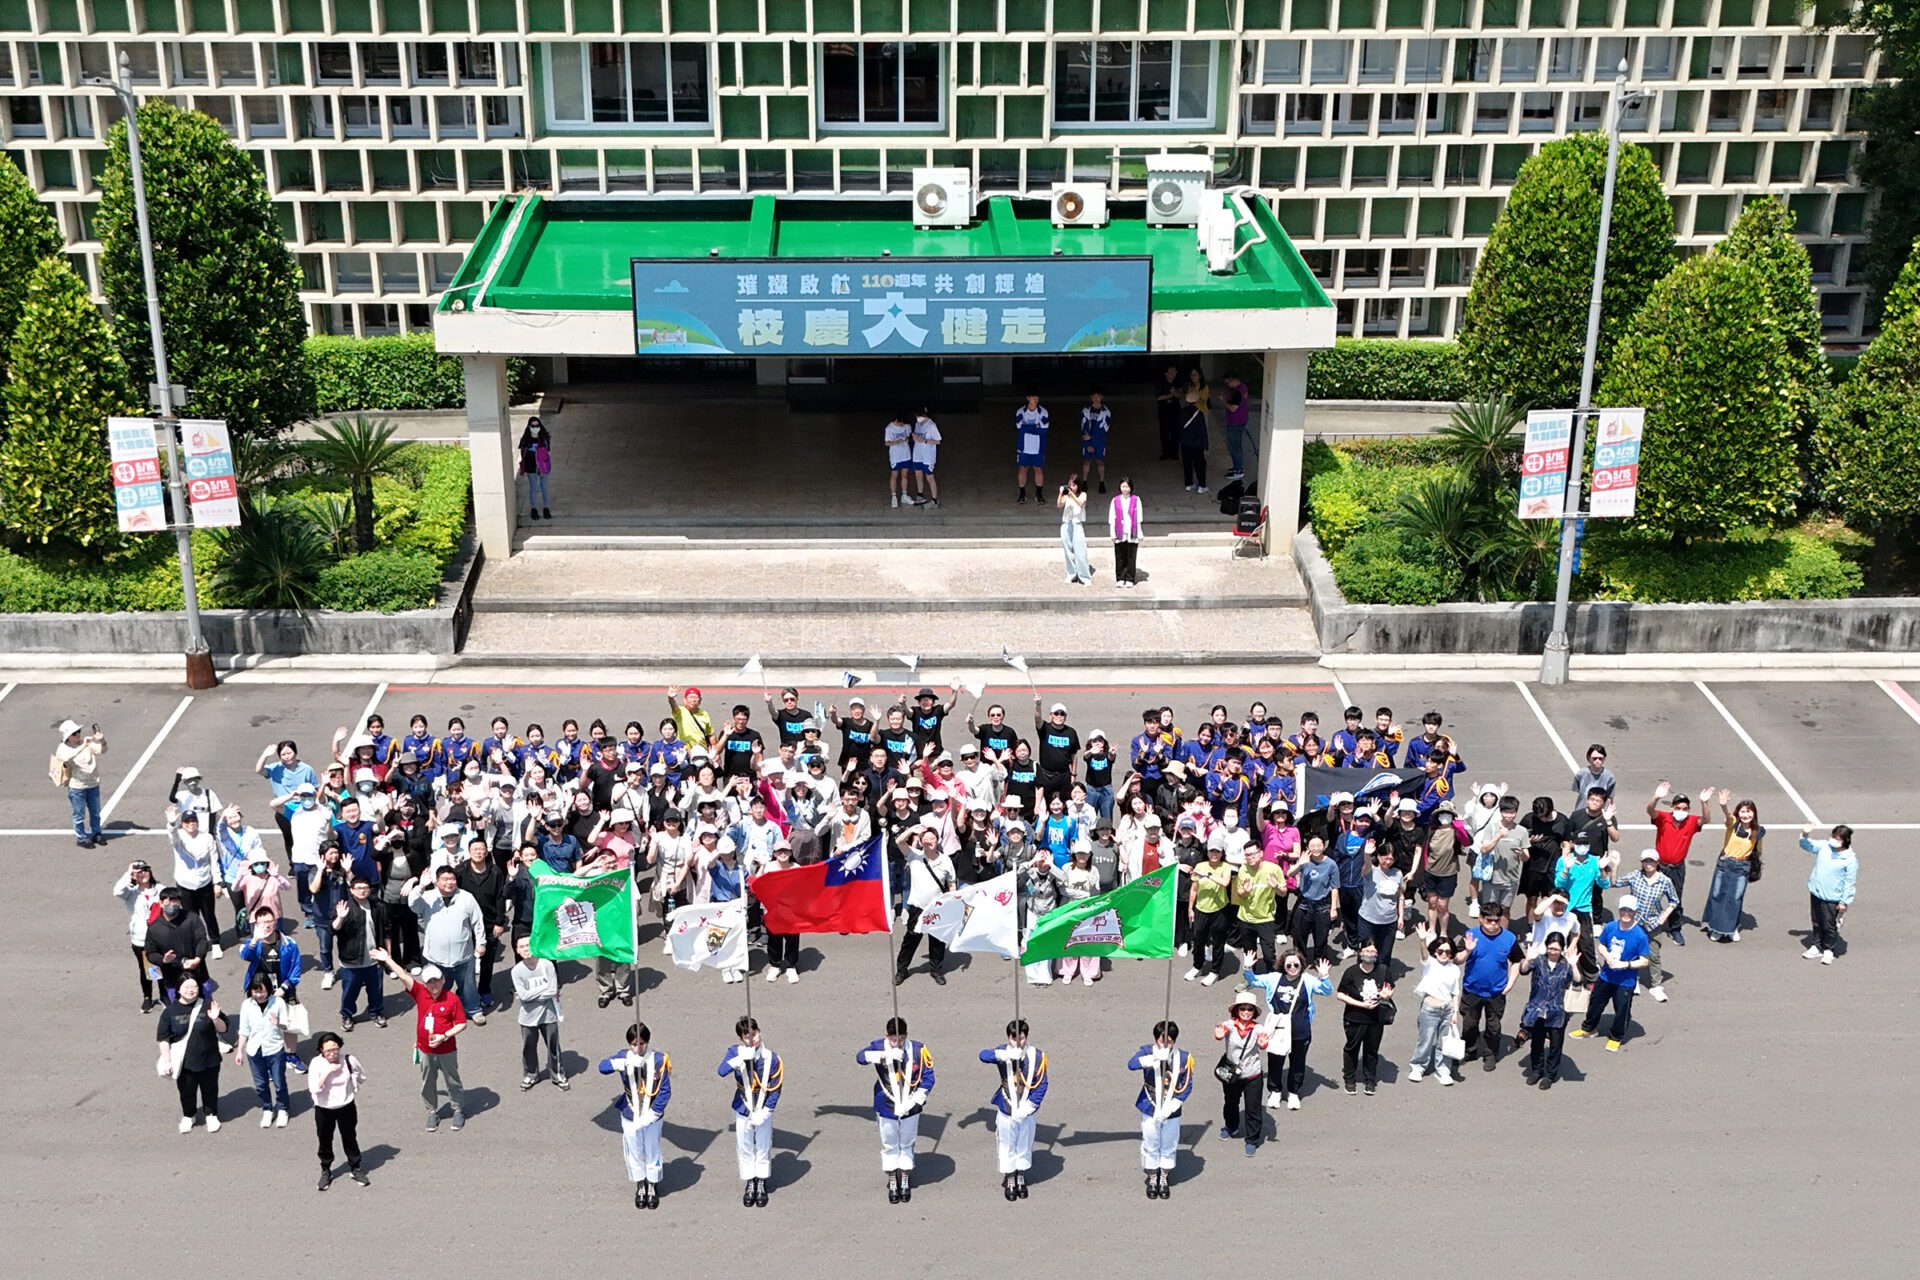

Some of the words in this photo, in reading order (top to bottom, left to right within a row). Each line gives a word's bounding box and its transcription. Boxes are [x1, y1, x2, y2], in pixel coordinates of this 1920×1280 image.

[736, 273, 851, 296] 璀璨啟航
[862, 273, 927, 288] 110週年
[934, 272, 1045, 295] 共創輝煌
[737, 291, 1047, 349] 校慶大健走
